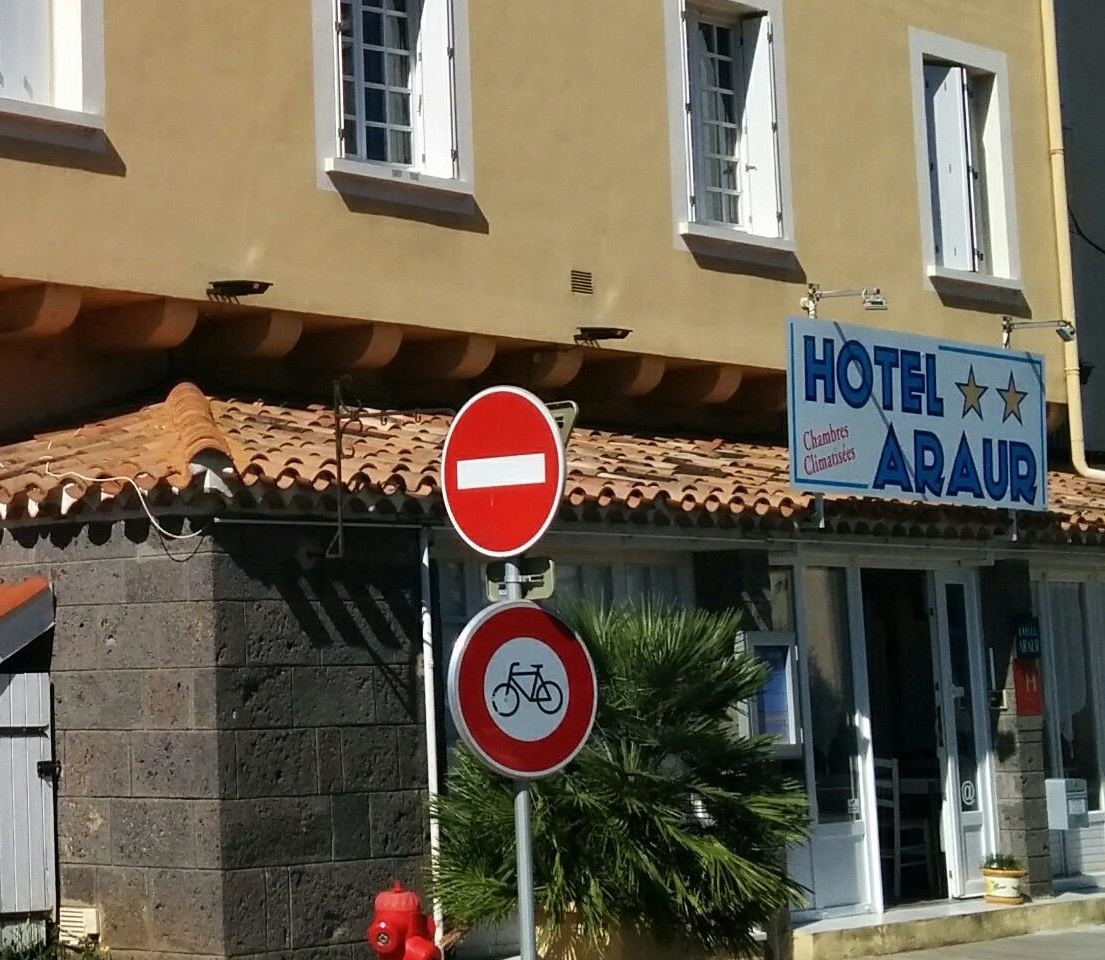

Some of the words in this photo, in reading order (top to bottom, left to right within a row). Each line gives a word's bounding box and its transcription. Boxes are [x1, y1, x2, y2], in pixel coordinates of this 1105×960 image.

[803, 334, 944, 417] HOTEL
[804, 423, 849, 451] Chambres
[872, 422, 1037, 506] ARAUR
